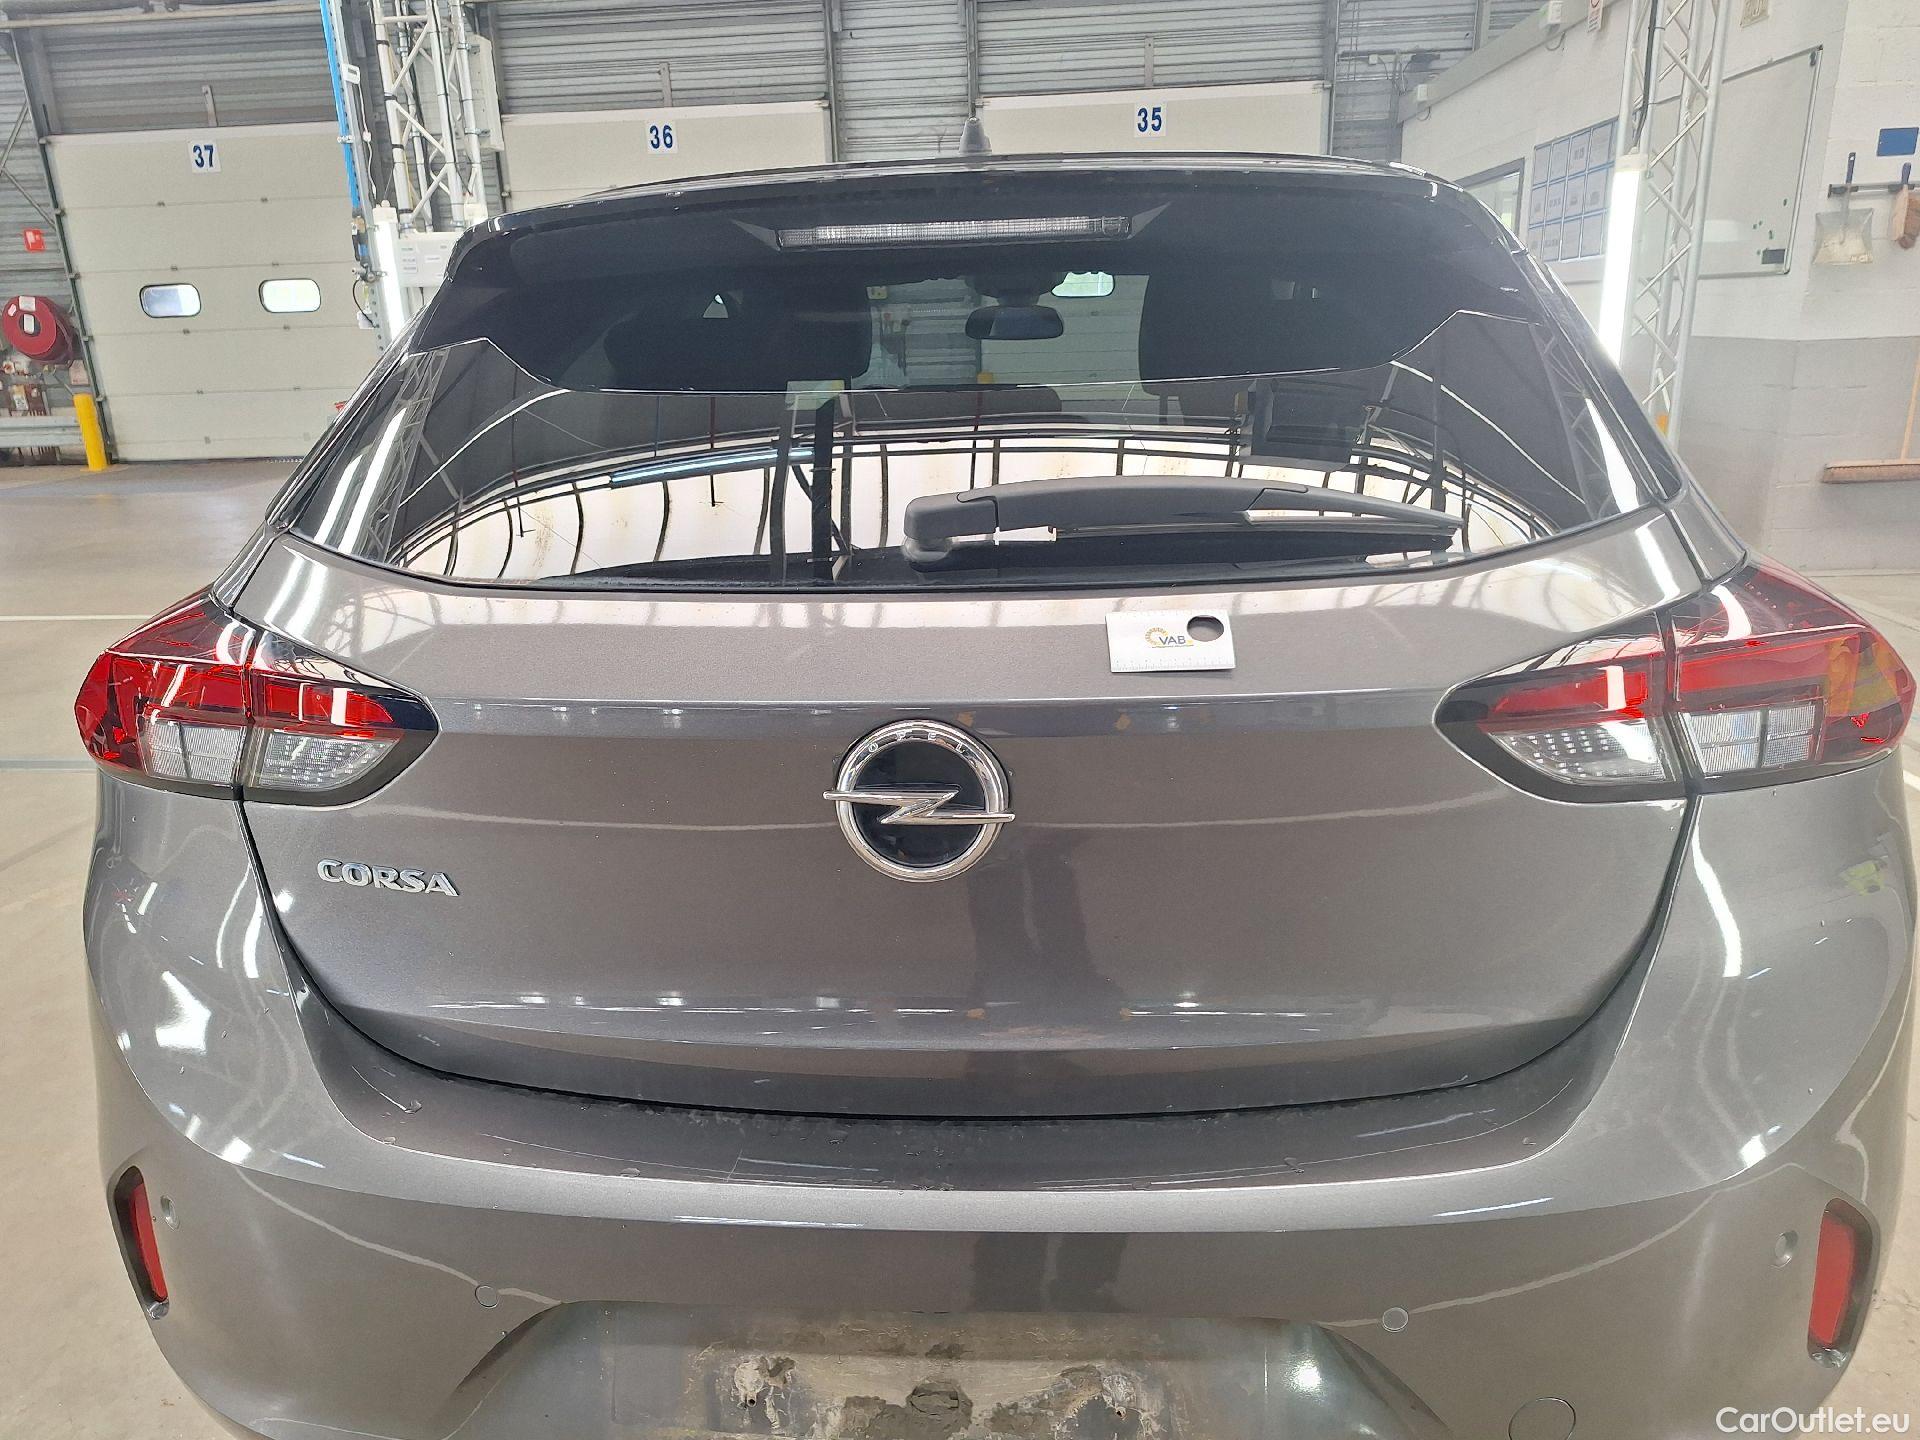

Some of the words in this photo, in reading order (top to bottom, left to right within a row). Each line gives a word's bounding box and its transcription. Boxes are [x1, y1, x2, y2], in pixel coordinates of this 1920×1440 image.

[1137, 107, 1162, 132] 35
[650, 125, 673, 149] 36
[193, 144, 214, 168] 37
[1158, 635, 1186, 646] VAB
[867, 731, 966, 754] OPEL
[317, 858, 459, 897] CORSA
